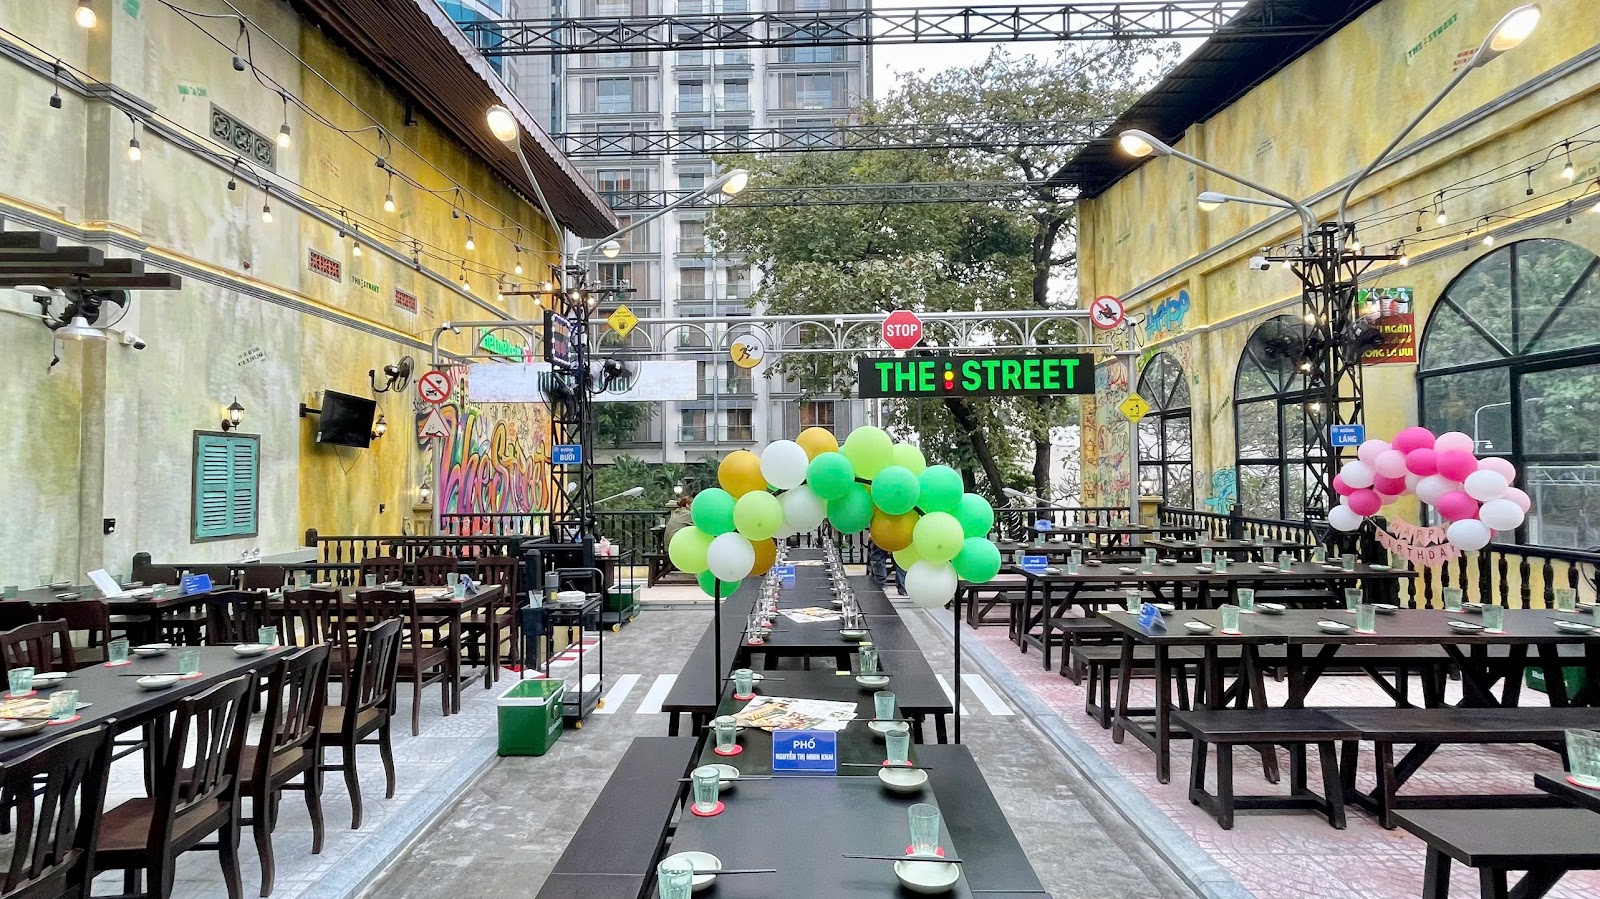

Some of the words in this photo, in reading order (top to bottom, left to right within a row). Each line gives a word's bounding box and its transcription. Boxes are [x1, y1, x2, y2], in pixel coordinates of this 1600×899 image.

[886, 323, 919, 337] STOP
[875, 361, 936, 392] THE
[961, 358, 1080, 391] STREET
[792, 736, 817, 750] PHỐ
